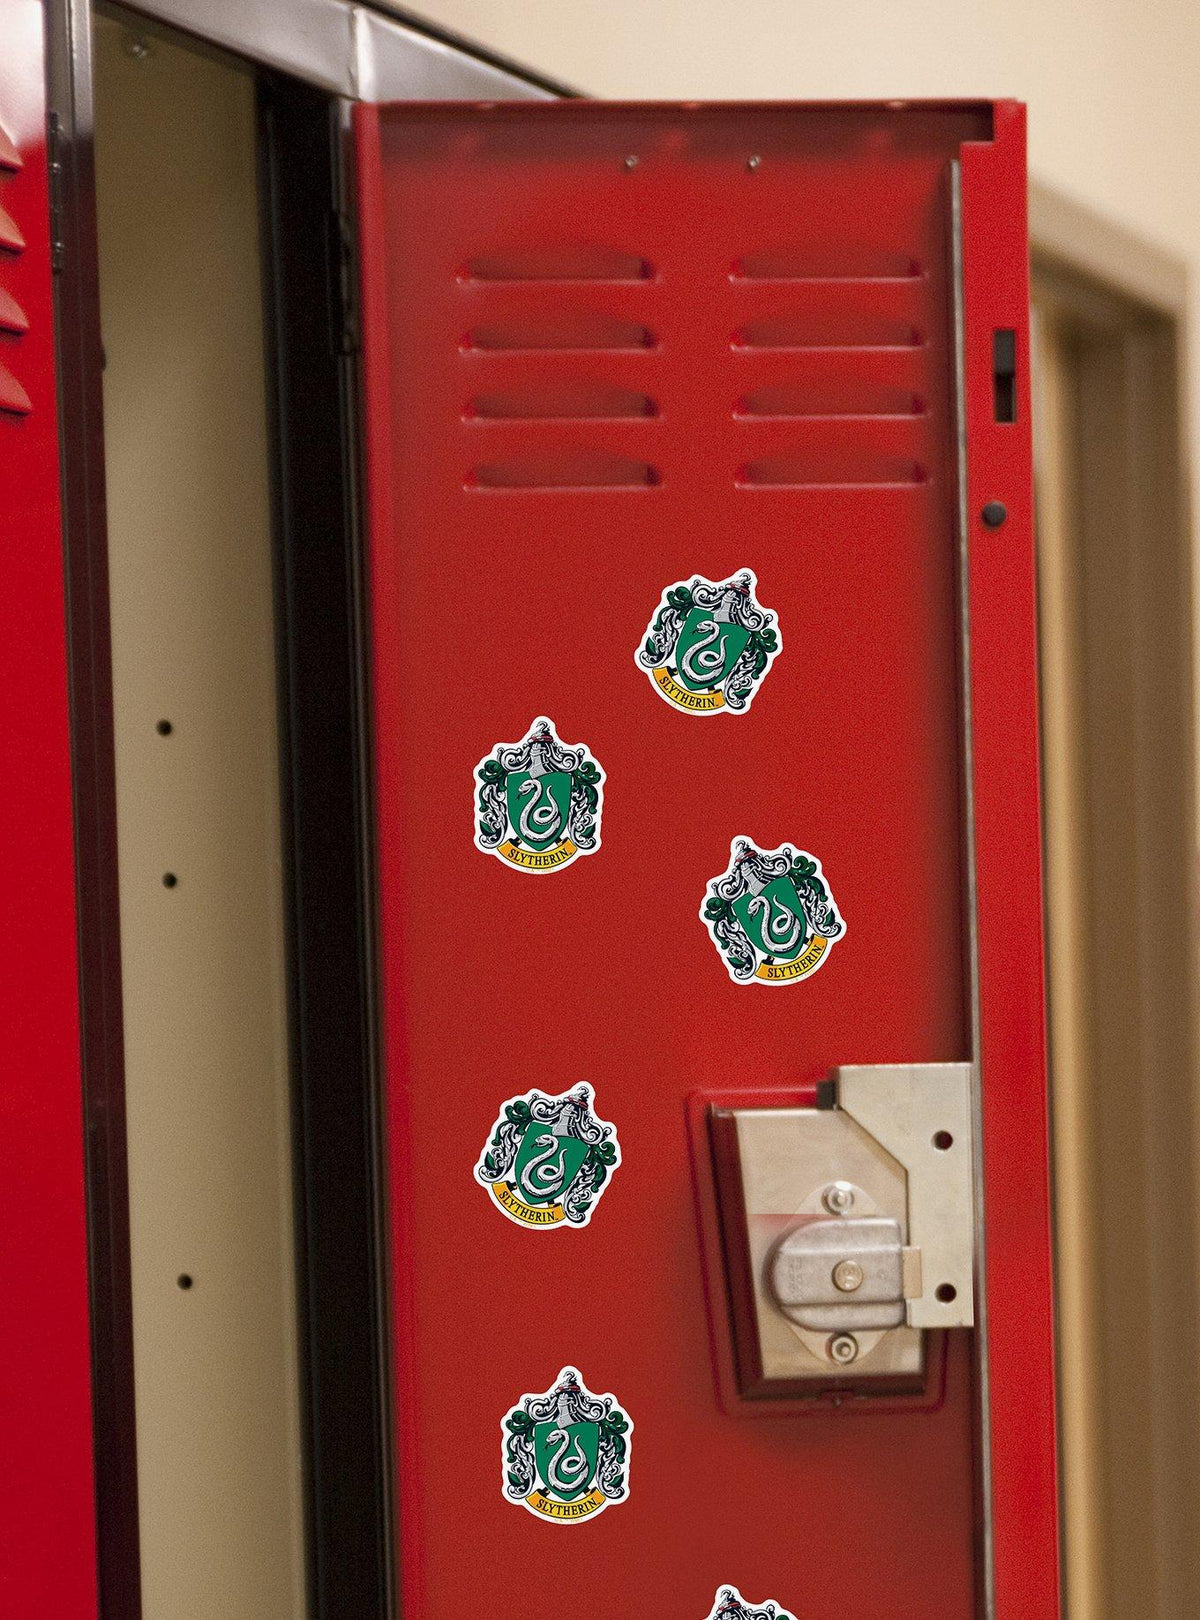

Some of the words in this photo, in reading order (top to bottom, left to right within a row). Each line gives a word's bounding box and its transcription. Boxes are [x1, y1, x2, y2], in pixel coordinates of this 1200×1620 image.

[660, 676, 715, 708] SLYTHERIN
[508, 848, 569, 865] SLYTHERIN
[767, 945, 822, 978] SLYTHERIN
[499, 1191, 555, 1222] SLYTHERIN
[536, 1497, 597, 1516] SLYTHERIN
